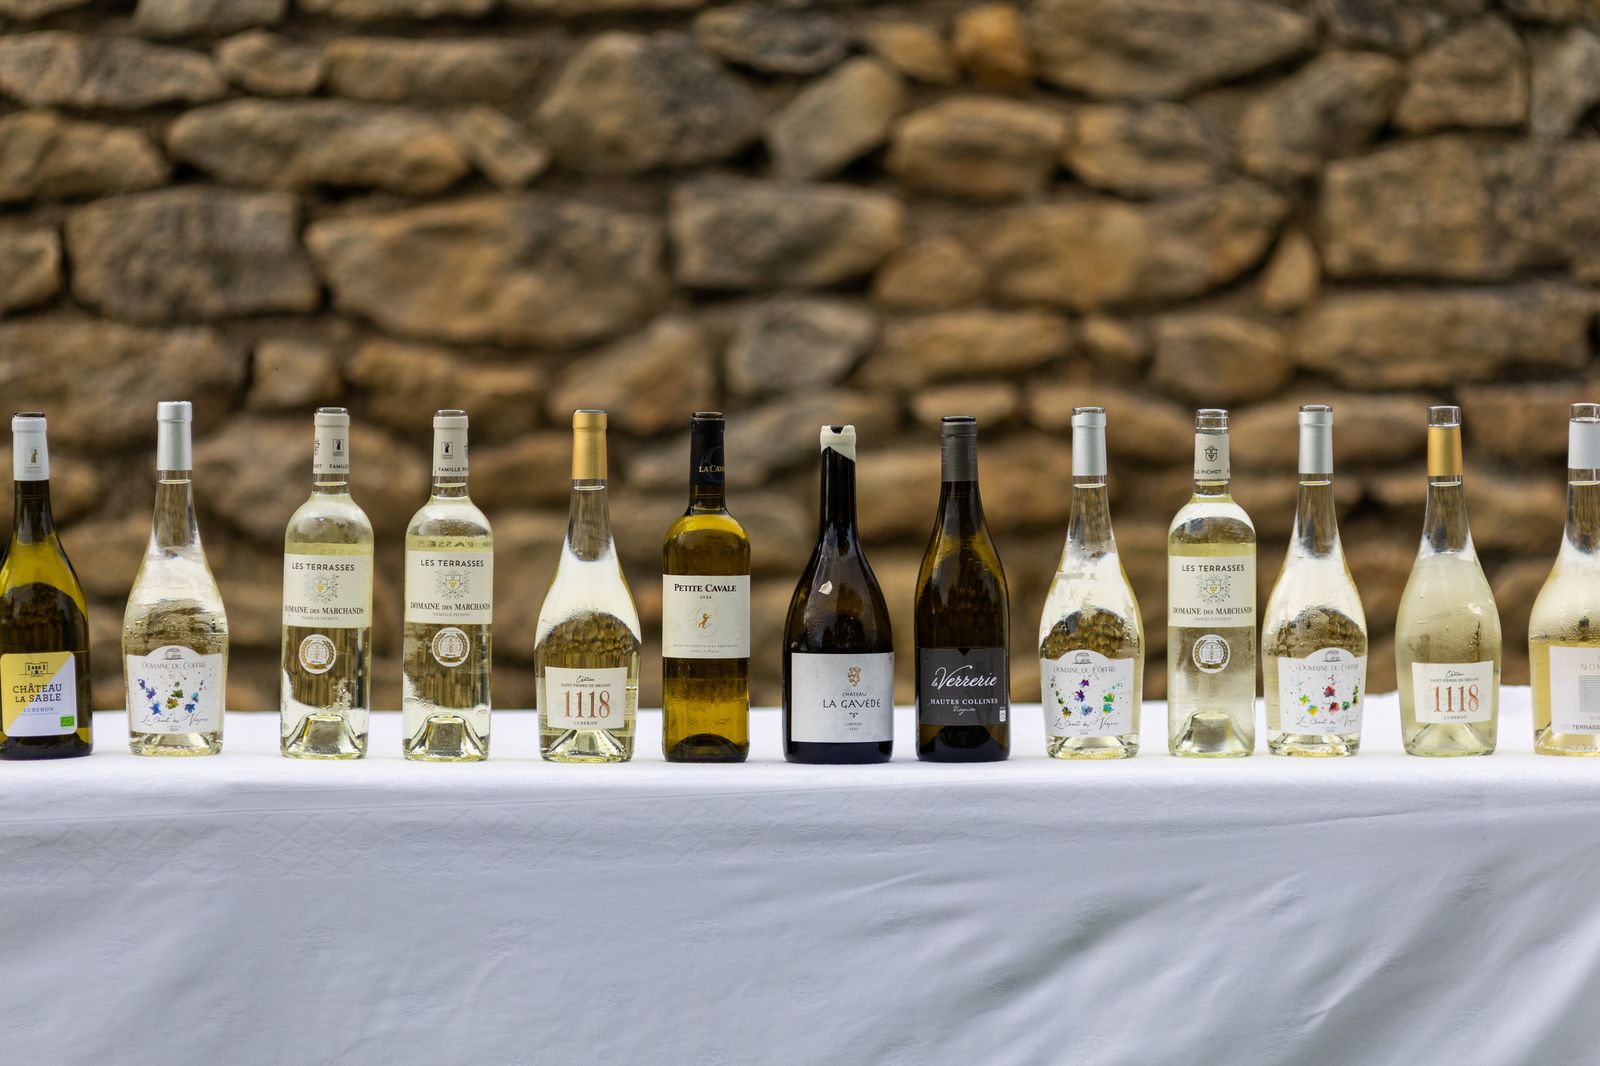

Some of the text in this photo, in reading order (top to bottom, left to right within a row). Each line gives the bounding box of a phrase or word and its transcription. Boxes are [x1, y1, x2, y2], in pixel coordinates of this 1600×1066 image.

[292, 562, 355, 571] LES TERRASSES
[420, 559, 435, 567] LES
[1182, 564, 1245, 572] LES TERRASSES
[674, 583, 737, 592] PETITE CAVALE
[322, 607, 364, 615] MARCHANDS
[411, 602, 440, 610] DOMAINE
[454, 603, 491, 611] MARCHANDS
[1173, 606, 1201, 615] DOMAINE
[1216, 606, 1253, 615] MARCHANDS
[141, 661, 168, 670] DOMAINE
[1053, 665, 1078, 673] DOMAINE
[1298, 663, 1328, 672] DOMAINE
[935, 665, 998, 690] Verrerie
[12, 682, 62, 693] CHÂTEAU
[28, 693, 61, 703] SABLE
[1433, 684, 1479, 713] 1118
[563, 690, 611, 719] 1118
[823, 699, 837, 708] LA
